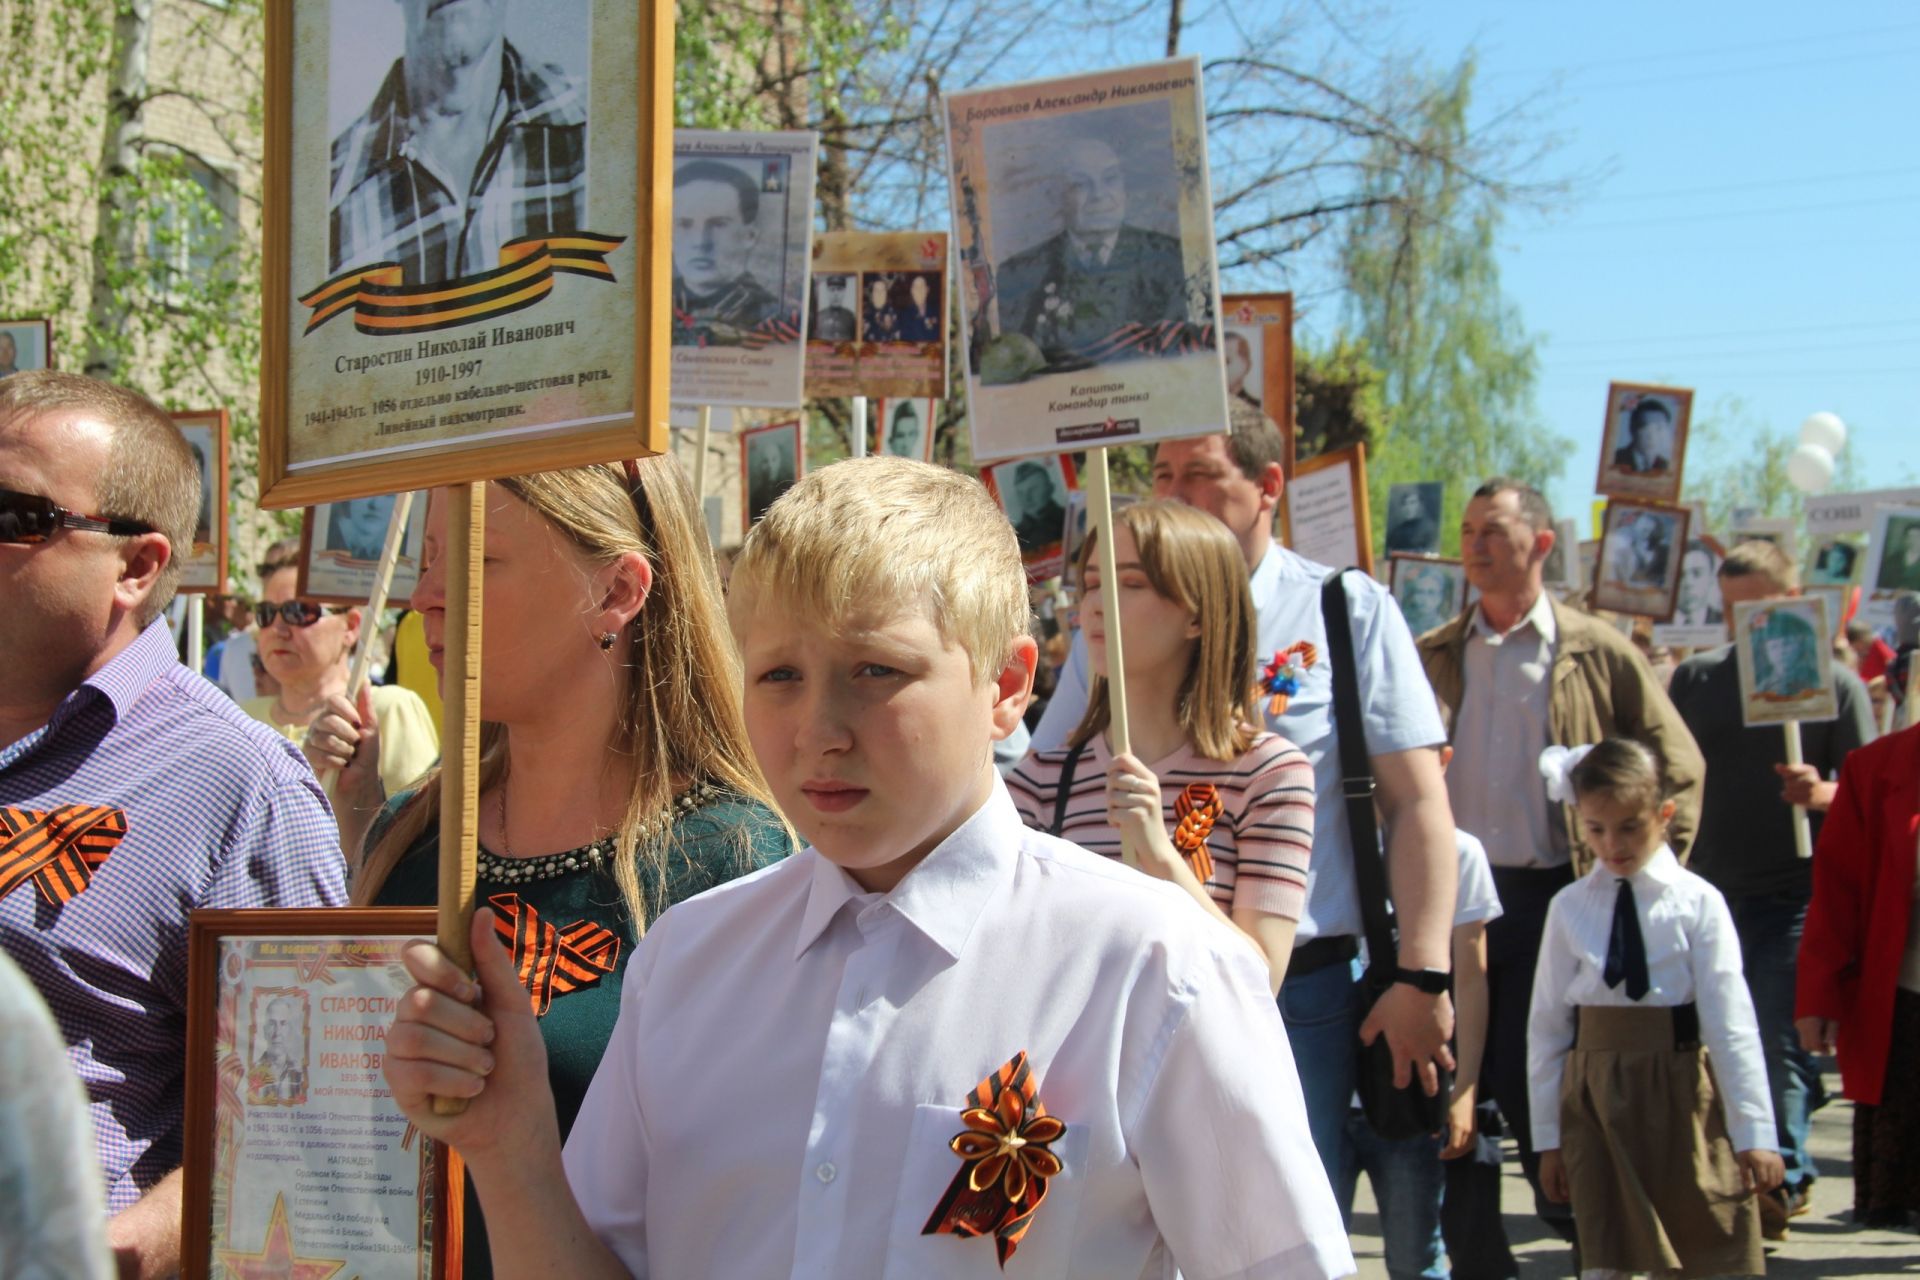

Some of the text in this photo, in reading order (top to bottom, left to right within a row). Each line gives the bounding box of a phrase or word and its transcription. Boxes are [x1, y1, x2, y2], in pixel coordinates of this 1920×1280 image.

[966, 77, 1195, 122] Боровков Александр Николаевич
[335, 320, 575, 374] Старостин Николай Иванович
[416, 360, 482, 386] 1910-1997
[372, 398, 397, 415] 1056
[401, 391, 451, 410] отдельно
[455, 374, 575, 402] кабельно-шестовая
[578, 369, 613, 387] рота.
[1070, 382, 1125, 397] Капитан
[1048, 392, 1149, 413] Командир танка
[375, 415, 436, 436] Линейный
[320, 996, 397, 1013] СТАРОСТИ
[320, 1052, 385, 1069] ИВАНОВ
[314, 1085, 334, 1096] МОЙ
[296, 1111, 327, 1121] Великой
[305, 1125, 322, 1135] 1056
[327, 1155, 374, 1166] НАГРАЖДЕН
[295, 1168, 392, 1182] Орденом Красной Звезды
[295, 1183, 414, 1196] Орденом Отечественной войны
[346, 1213, 374, 1225] победу
